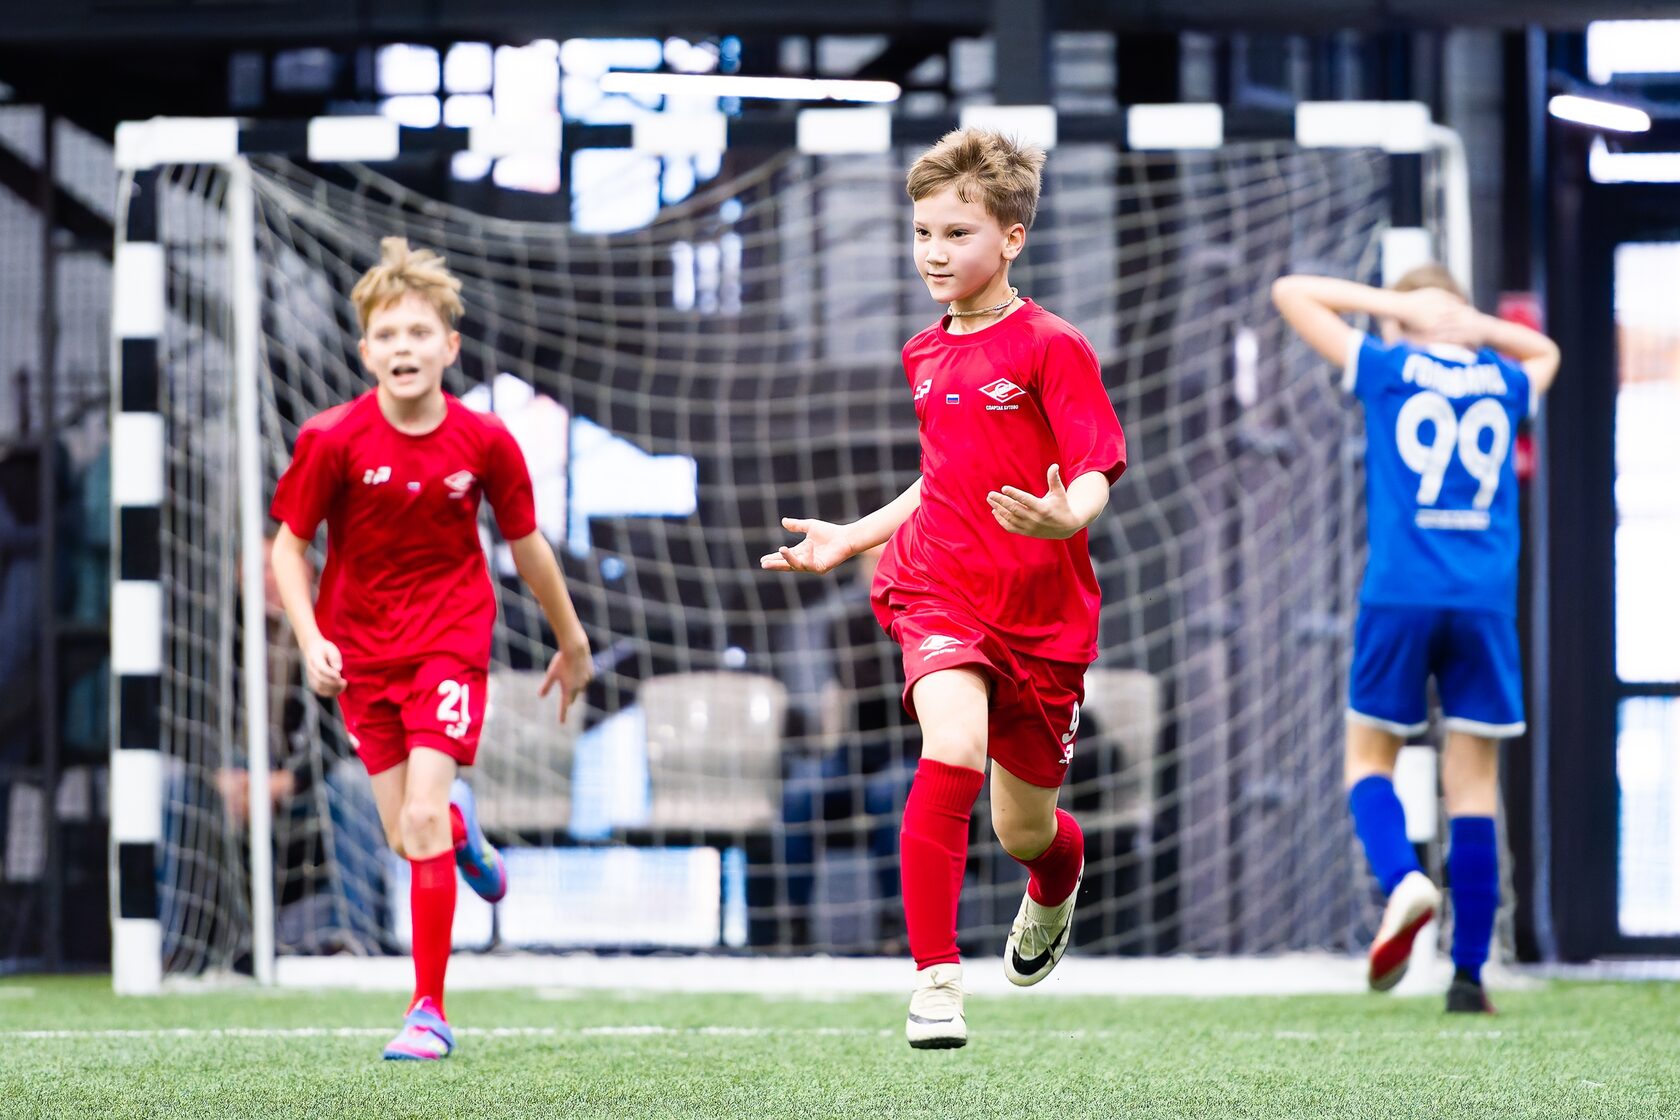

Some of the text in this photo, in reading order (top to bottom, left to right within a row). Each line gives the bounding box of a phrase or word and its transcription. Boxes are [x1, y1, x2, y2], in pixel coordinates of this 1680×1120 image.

[1395, 389, 1511, 510] 99
[436, 679, 471, 723] 21
[1062, 700, 1080, 744] 9
